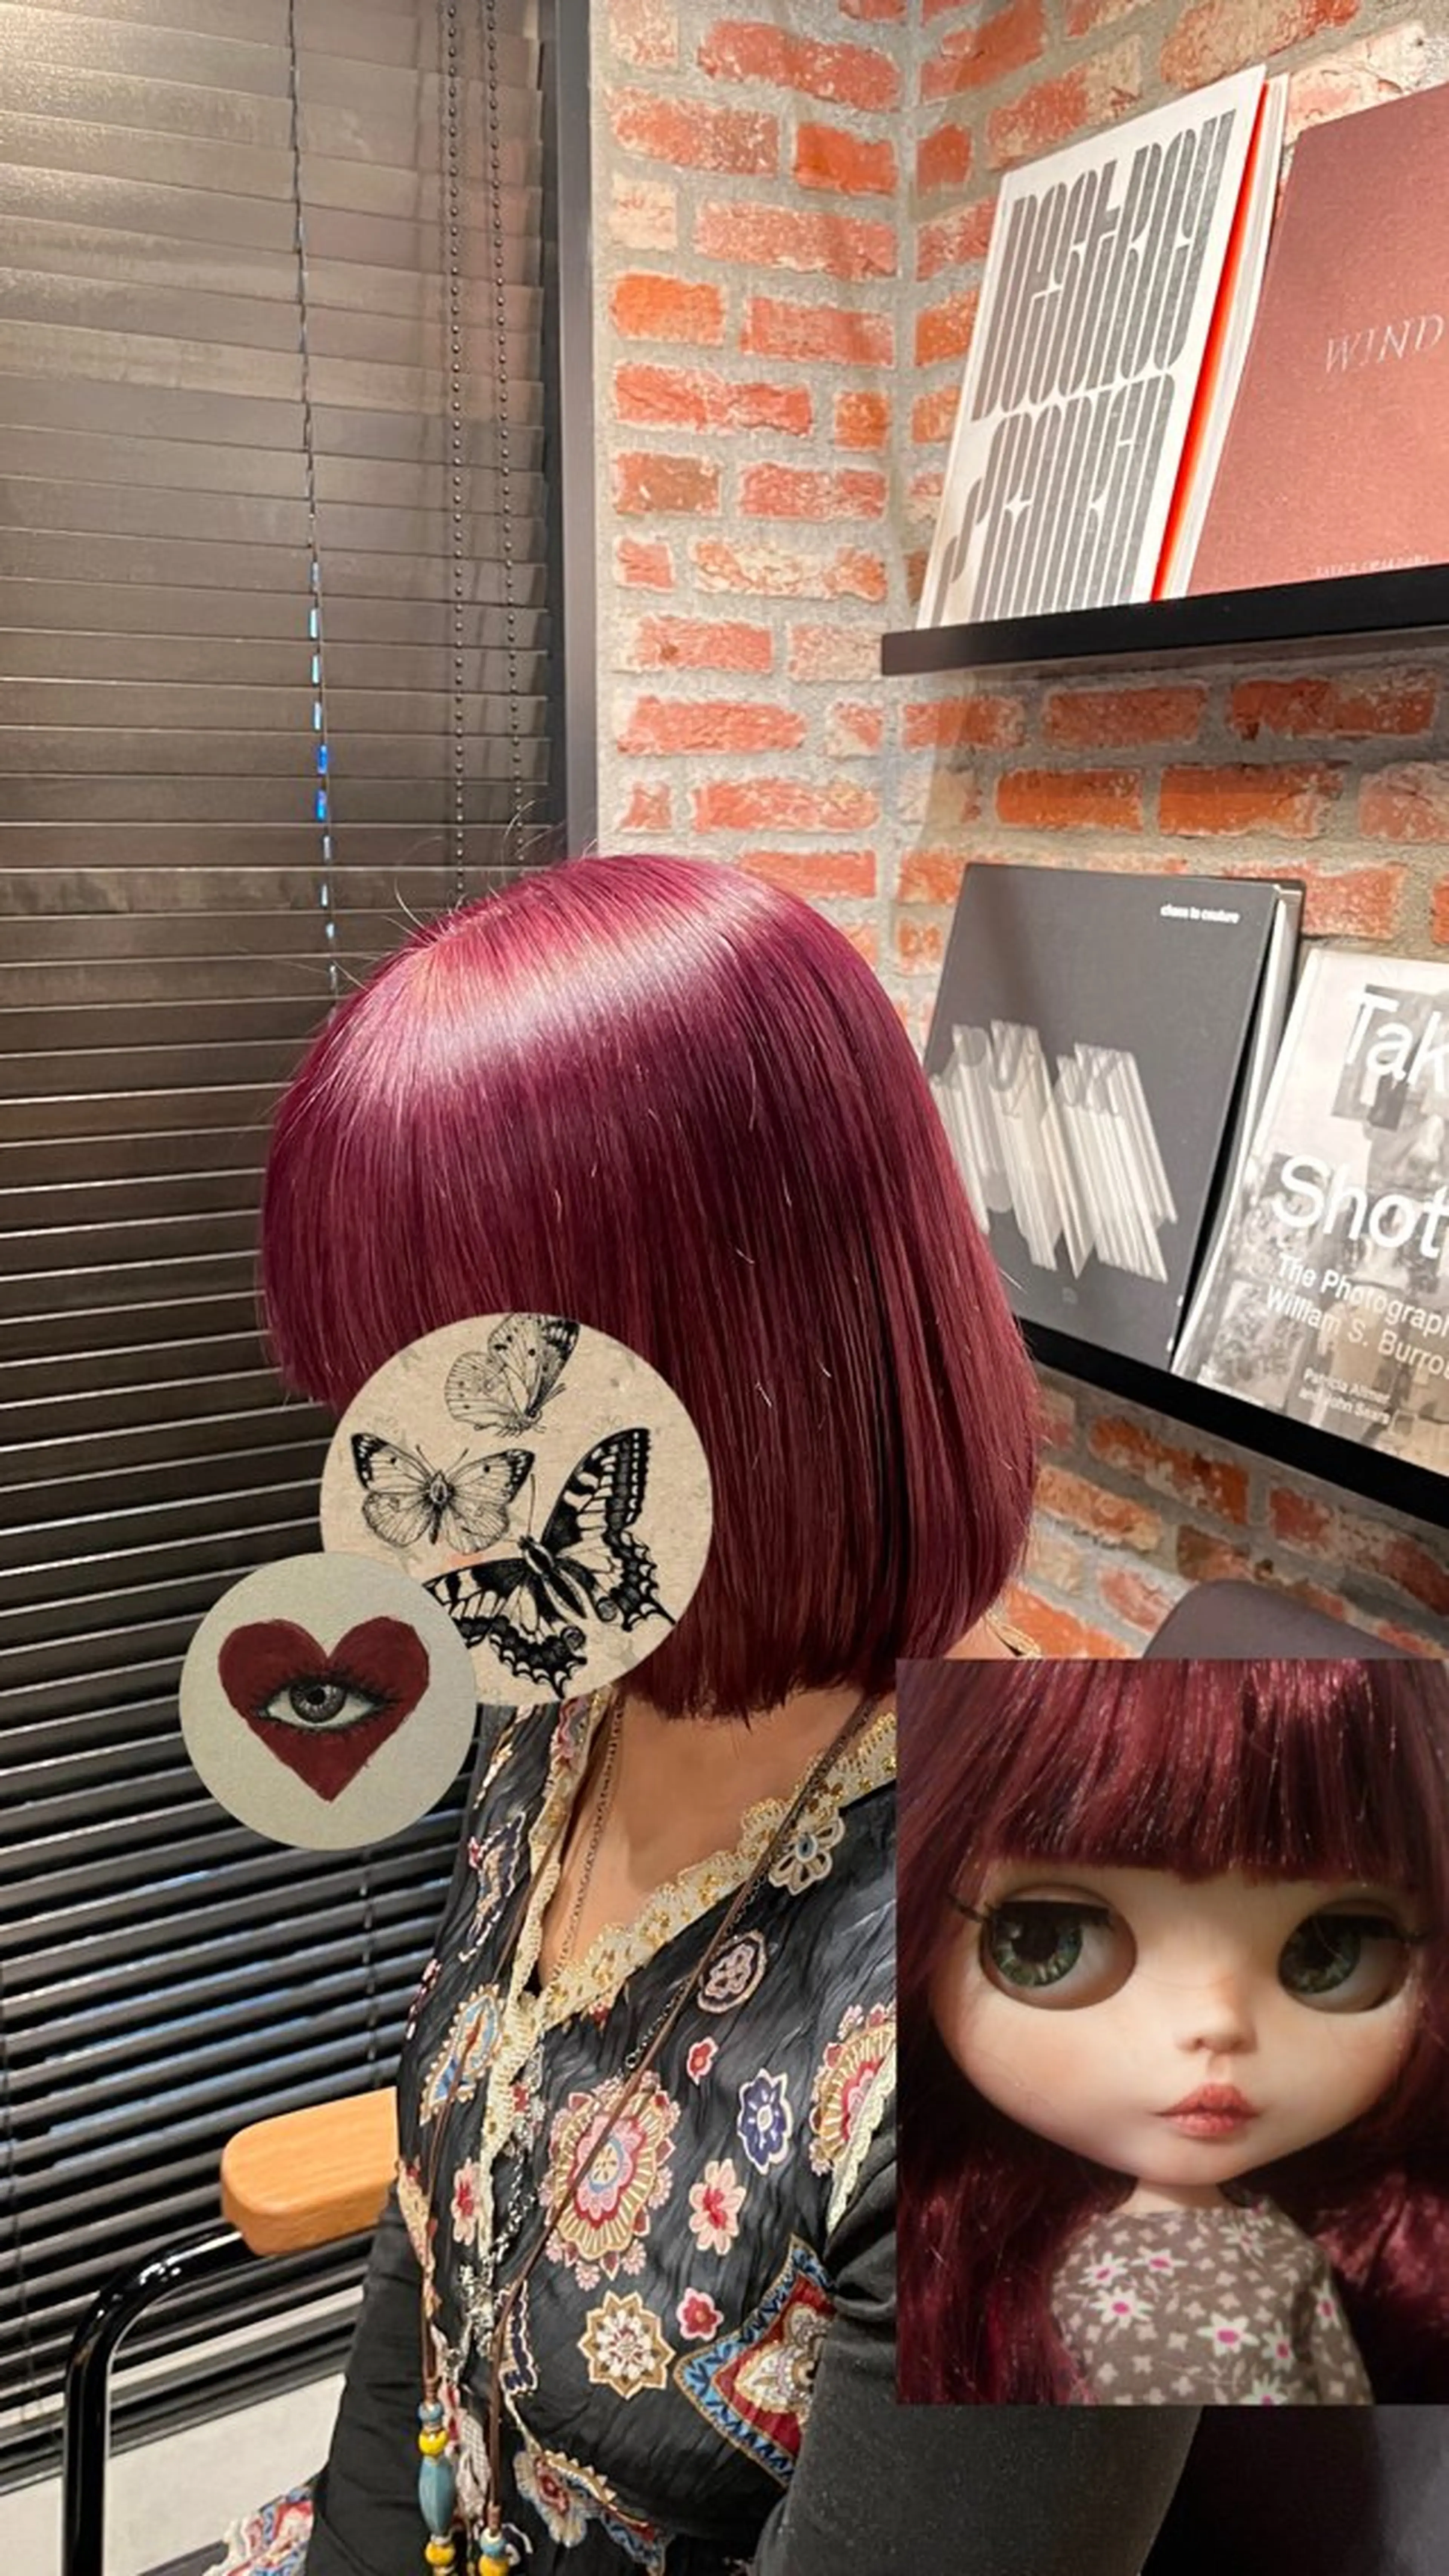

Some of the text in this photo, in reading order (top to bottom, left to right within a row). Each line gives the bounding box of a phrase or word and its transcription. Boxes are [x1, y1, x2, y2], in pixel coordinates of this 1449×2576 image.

[1279, 1252, 1317, 1288] The
[1267, 1284, 1341, 1336] William
[1347, 1318, 1369, 1348] S.
